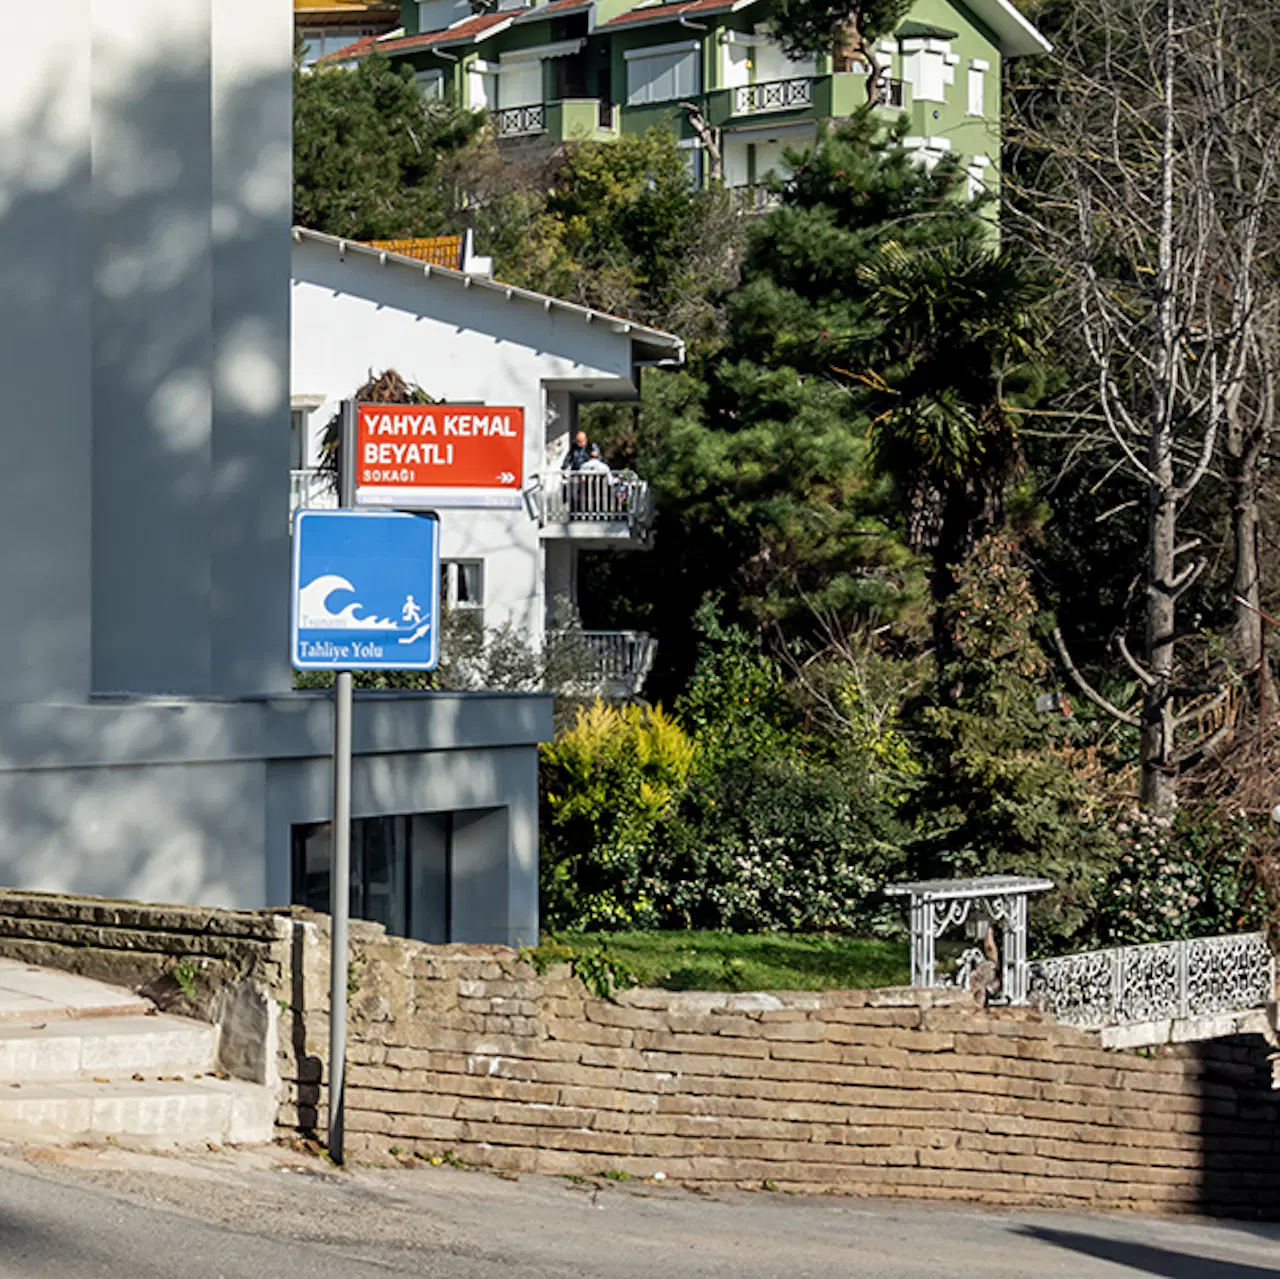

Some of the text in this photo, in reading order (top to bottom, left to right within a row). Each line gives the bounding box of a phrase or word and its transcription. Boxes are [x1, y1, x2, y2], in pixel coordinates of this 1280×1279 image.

[364, 415, 517, 437] YAHYA KEMAL
[364, 443, 454, 464] BEYATLI
[363, 468, 415, 482] SOKAĞI
[299, 641, 384, 662] Tahliye Yolu
